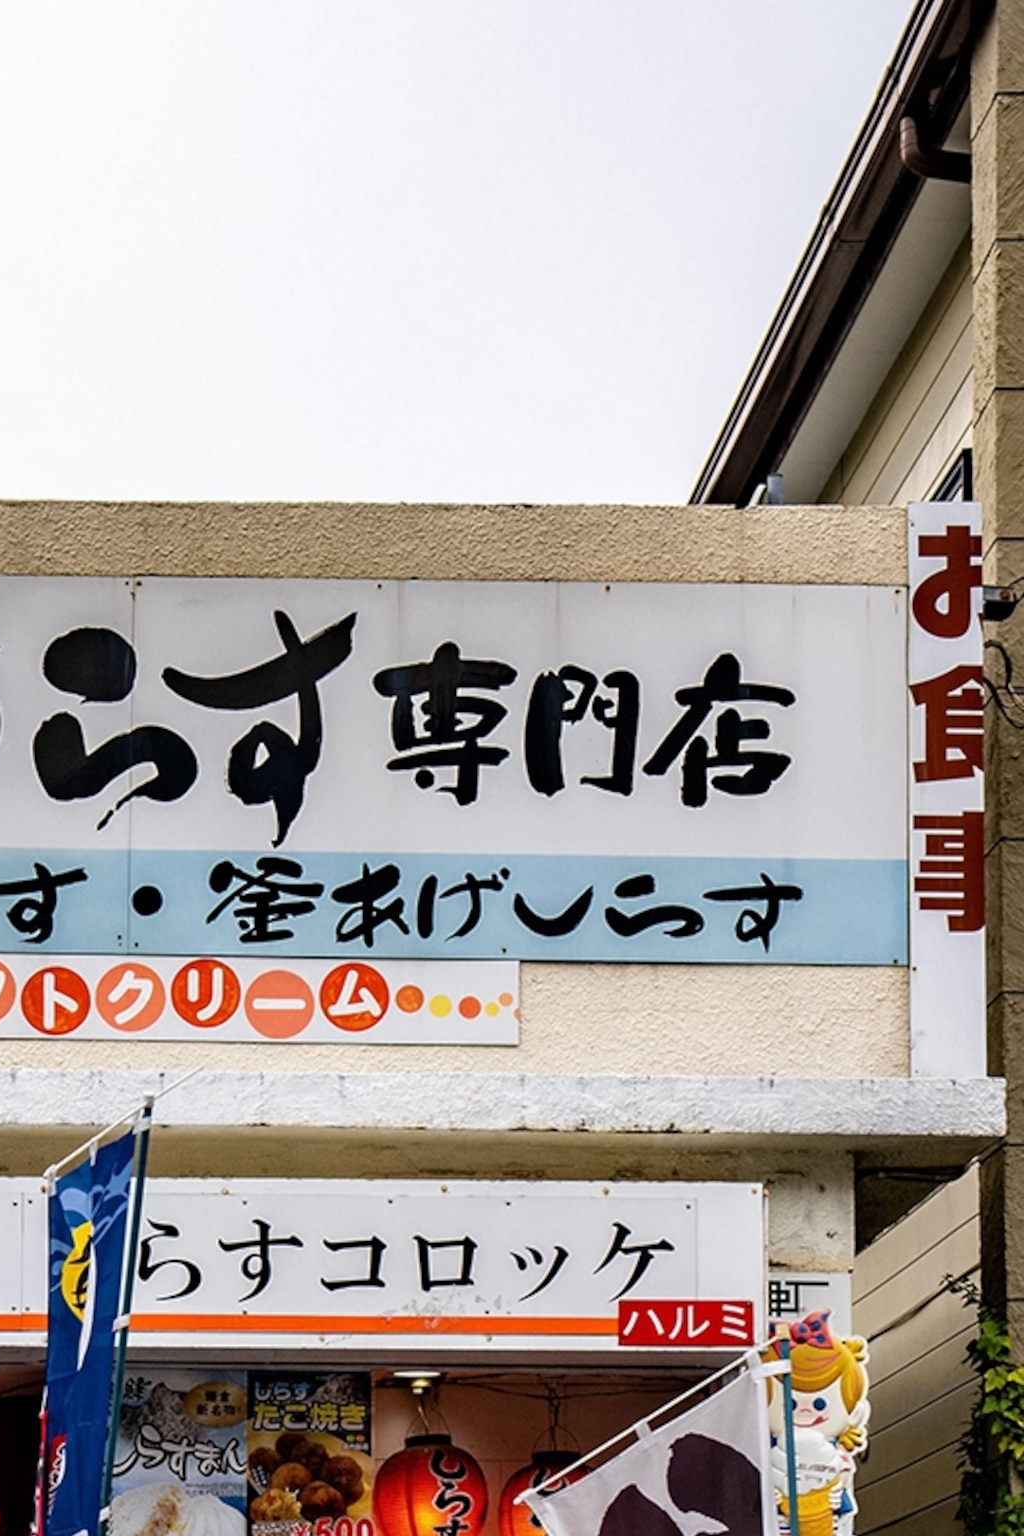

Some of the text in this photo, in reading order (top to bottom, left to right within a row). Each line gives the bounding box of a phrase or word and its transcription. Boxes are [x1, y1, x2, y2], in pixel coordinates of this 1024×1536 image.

[139, 1219, 675, 1302] らすコロッケ
[622, 1304, 748, 1341] ハルミ
[254, 1380, 312, 1402] しらす
[252, 1402, 367, 1432] たこ焼き
